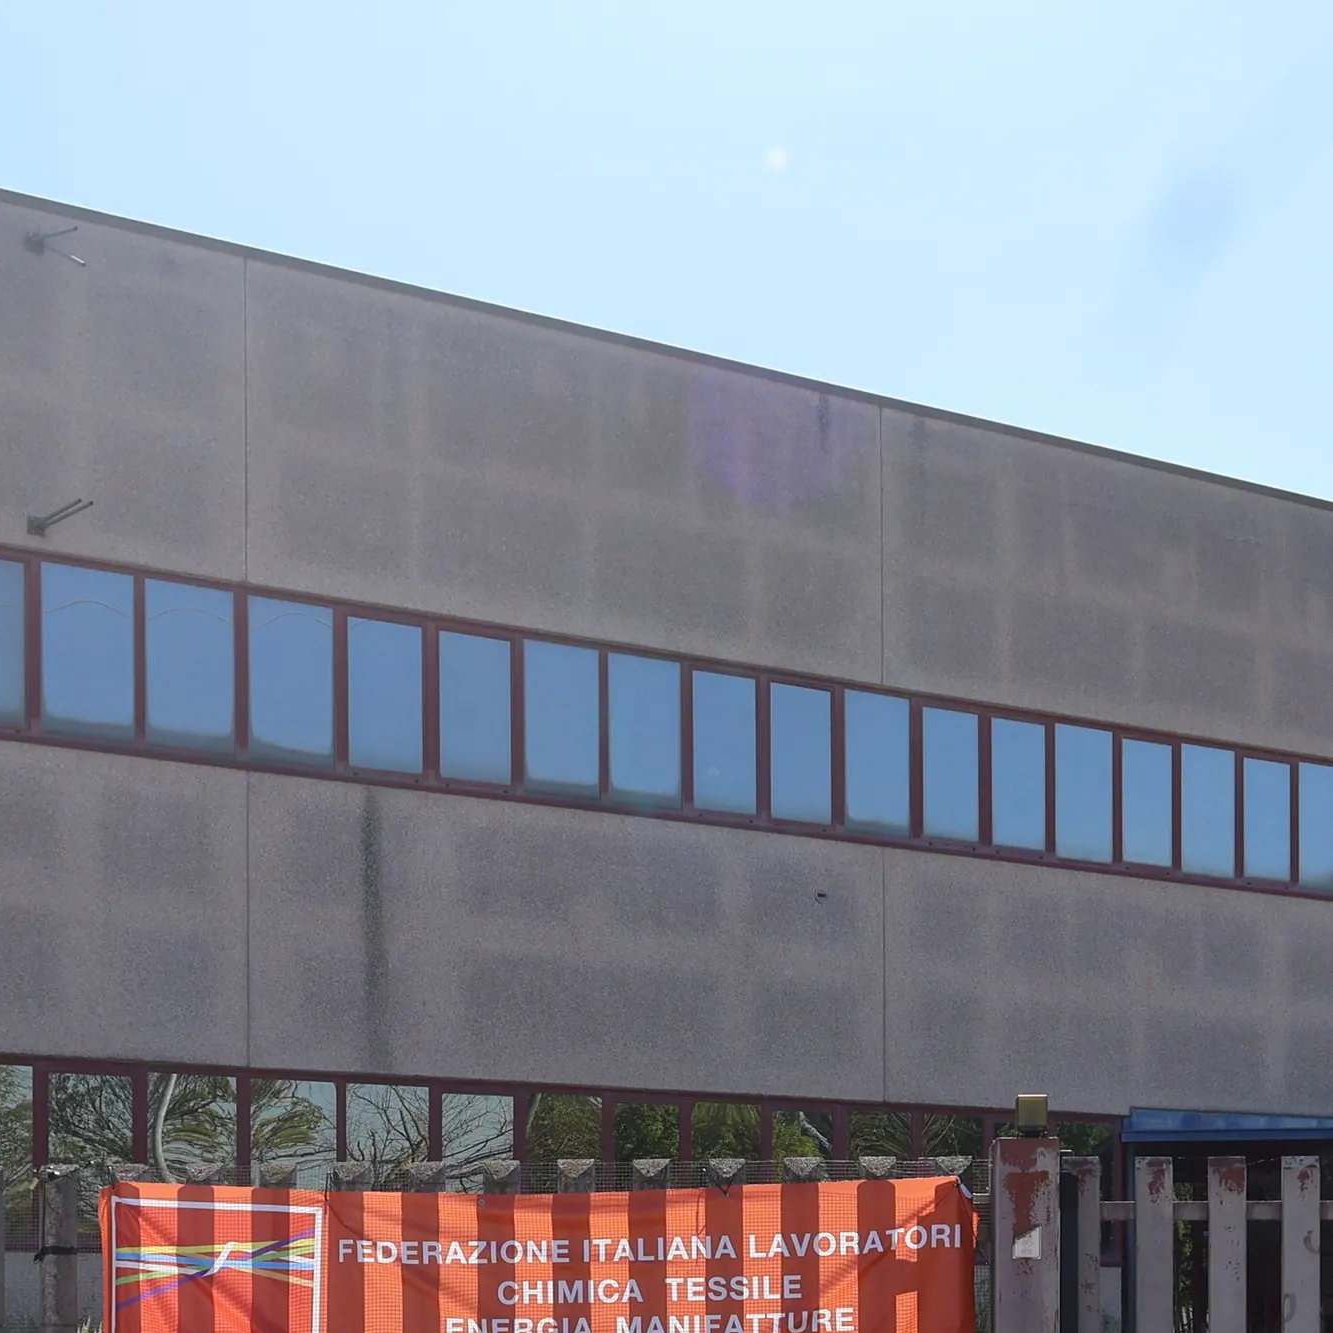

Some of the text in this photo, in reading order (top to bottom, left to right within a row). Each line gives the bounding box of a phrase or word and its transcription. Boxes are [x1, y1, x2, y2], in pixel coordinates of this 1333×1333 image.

[338, 1223, 961, 1265] FEDERAZIONE ITALIANA LAVORATORI
[497, 1274, 802, 1305] CHIMICA TESSILE
